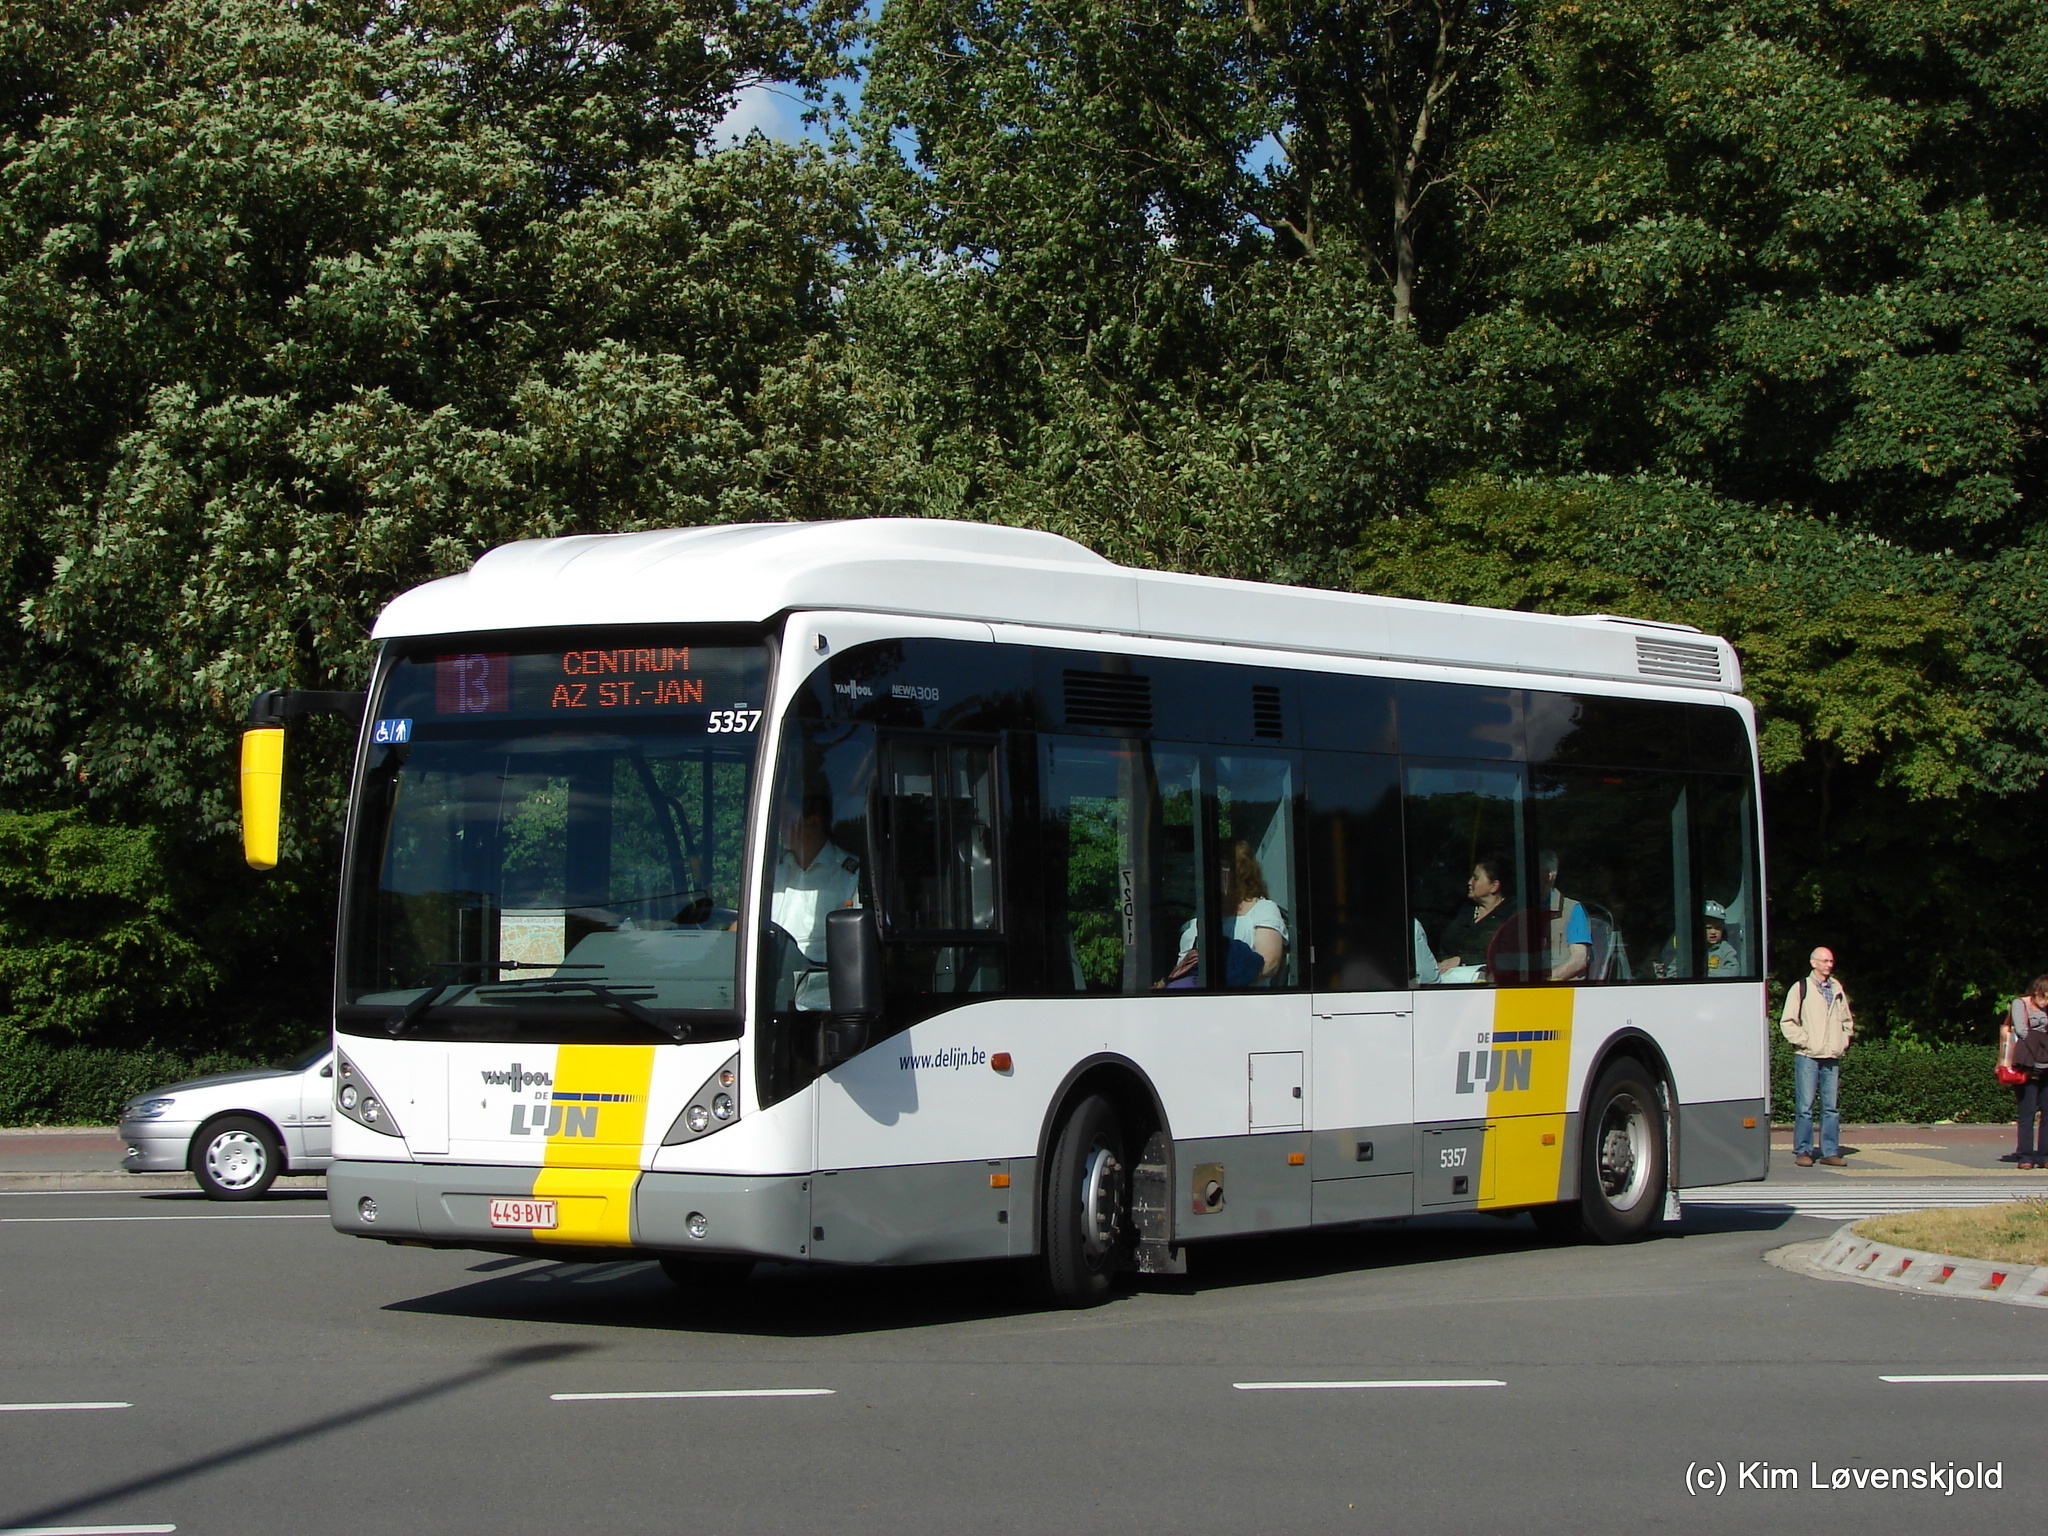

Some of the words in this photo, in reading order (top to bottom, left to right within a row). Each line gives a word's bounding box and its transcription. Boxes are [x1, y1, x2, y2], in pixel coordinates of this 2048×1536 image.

[563, 646, 690, 675] CENTRUM
[453, 653, 489, 714] 13
[552, 682, 588, 708] AZ
[598, 679, 703, 706] ST.-JAN
[706, 709, 763, 735] 5357
[1476, 1031, 1491, 1044] DE
[899, 1046, 987, 1071] www.delijn.be
[1455, 1048, 1533, 1095] LIJN
[534, 1091, 549, 1100] DE
[509, 1104, 600, 1138] LIJN
[1440, 1147, 1468, 1168] 5357
[493, 1202, 553, 1224] 449-BVT
